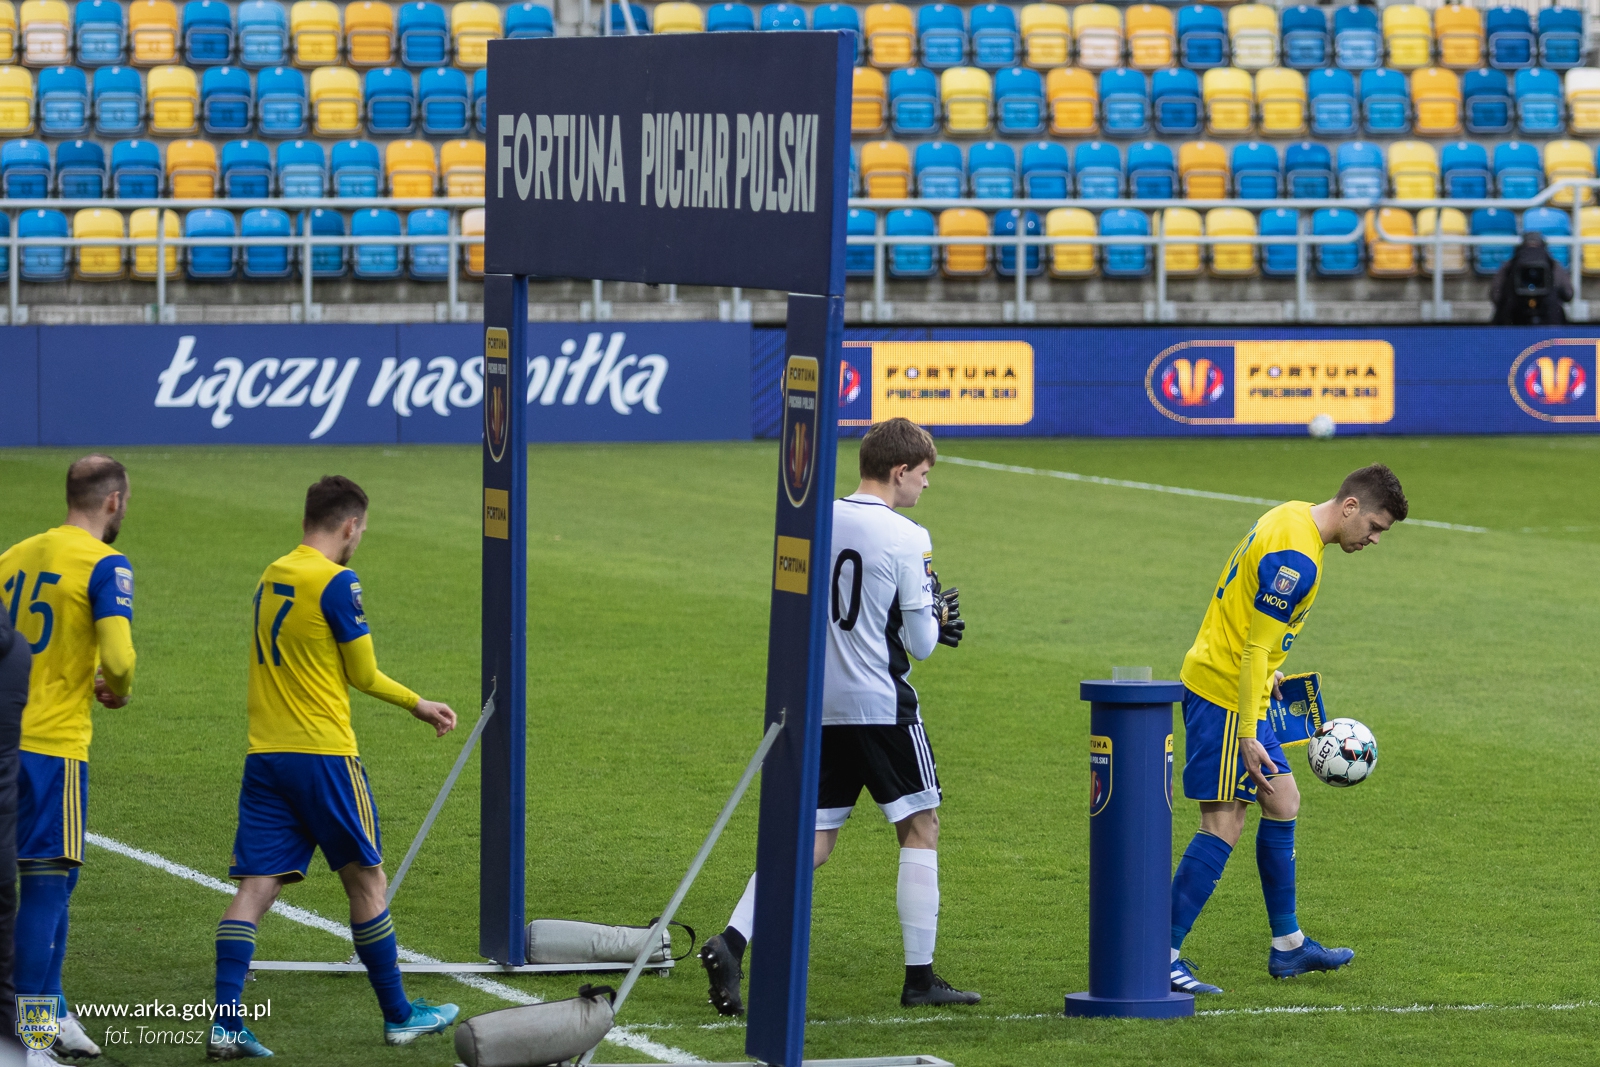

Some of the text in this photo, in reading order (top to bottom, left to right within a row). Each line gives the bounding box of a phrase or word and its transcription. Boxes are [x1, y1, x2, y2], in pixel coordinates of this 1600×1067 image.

[497, 111, 819, 214] FORTUNA PUCHAR POLSKI
[789, 367, 816, 382] FORTUNA
[887, 366, 1016, 379] FORTUNA
[1249, 366, 1377, 378] FORTUNA
[154, 335, 361, 439] Łączy
[367, 356, 484, 416] nas
[486, 506, 507, 521] FORTUNA
[779, 556, 806, 574] FORTUNA
[3, 569, 62, 655] 15
[253, 582, 295, 666] 17
[1305, 680, 1317, 702] ARKA
[1090, 740, 1107, 748] TUNA
[1314, 740, 1334, 775] SELECT
